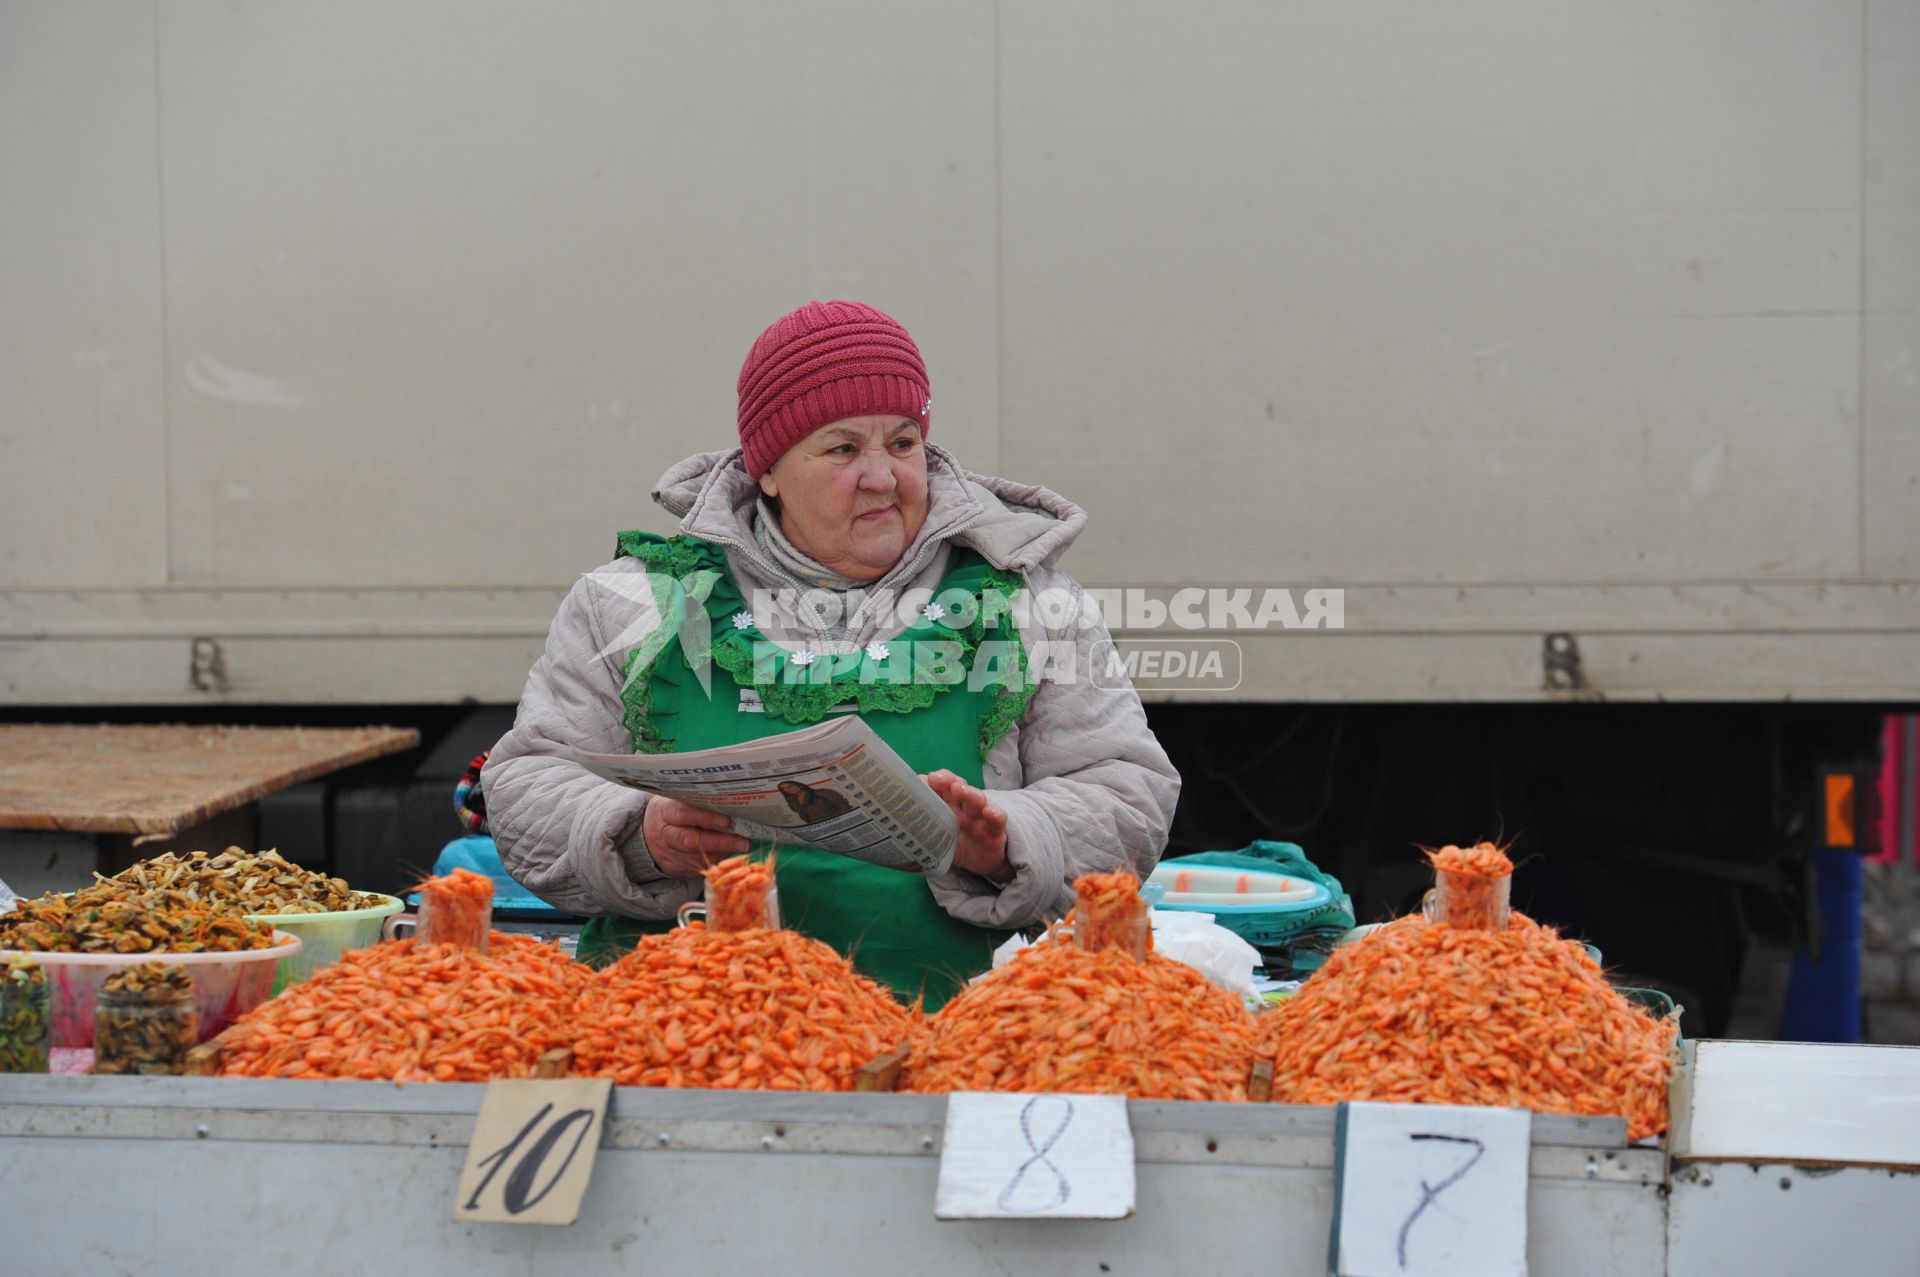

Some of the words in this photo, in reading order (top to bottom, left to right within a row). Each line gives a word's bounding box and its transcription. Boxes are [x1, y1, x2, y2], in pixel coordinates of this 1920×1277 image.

[463, 1102, 595, 1215] 10
[997, 1096, 1075, 1214] 8
[1397, 1132, 1487, 1269] 7
